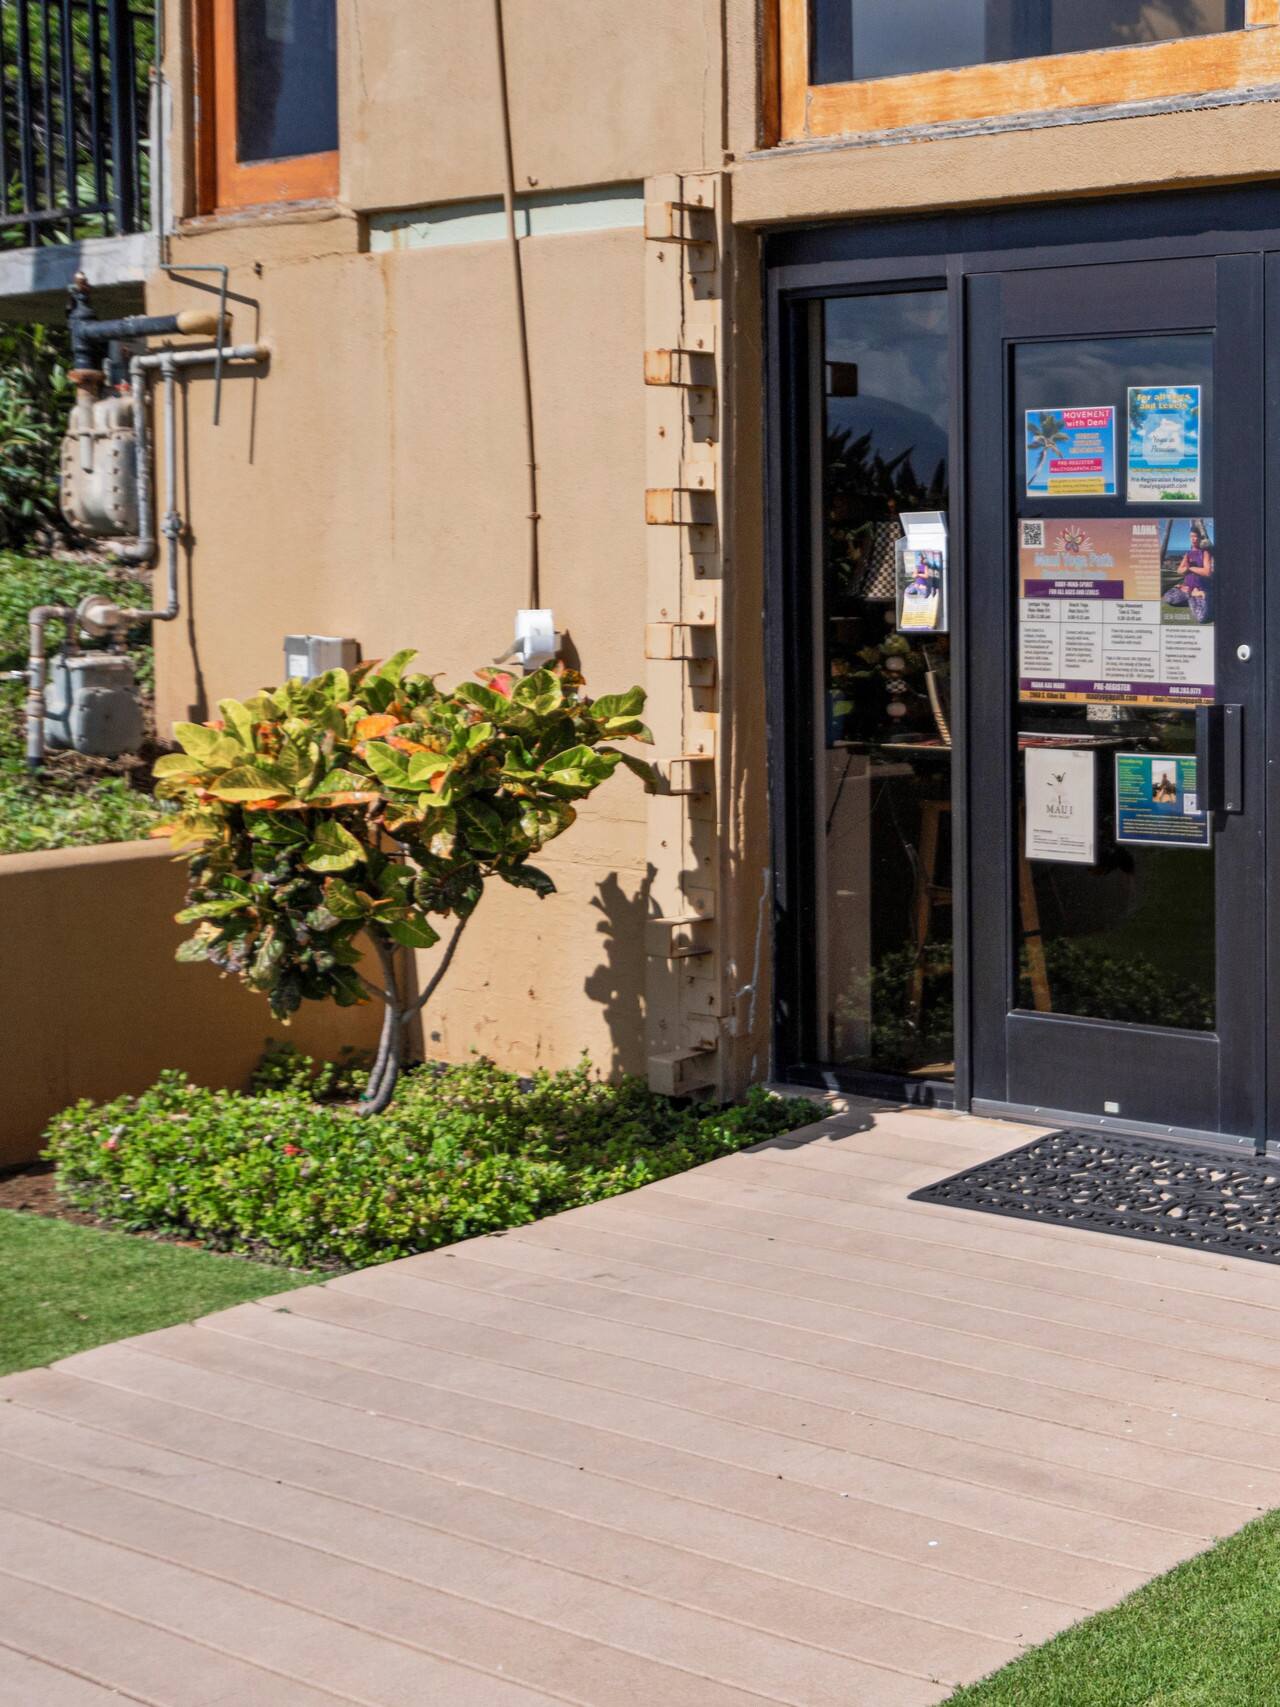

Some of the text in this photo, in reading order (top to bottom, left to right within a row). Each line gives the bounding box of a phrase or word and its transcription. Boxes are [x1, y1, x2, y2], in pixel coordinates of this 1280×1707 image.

[1063, 409, 1109, 419] MOVEMENT
[1087, 418, 1106, 426] Deni
[1046, 804, 1073, 815] MAUI
